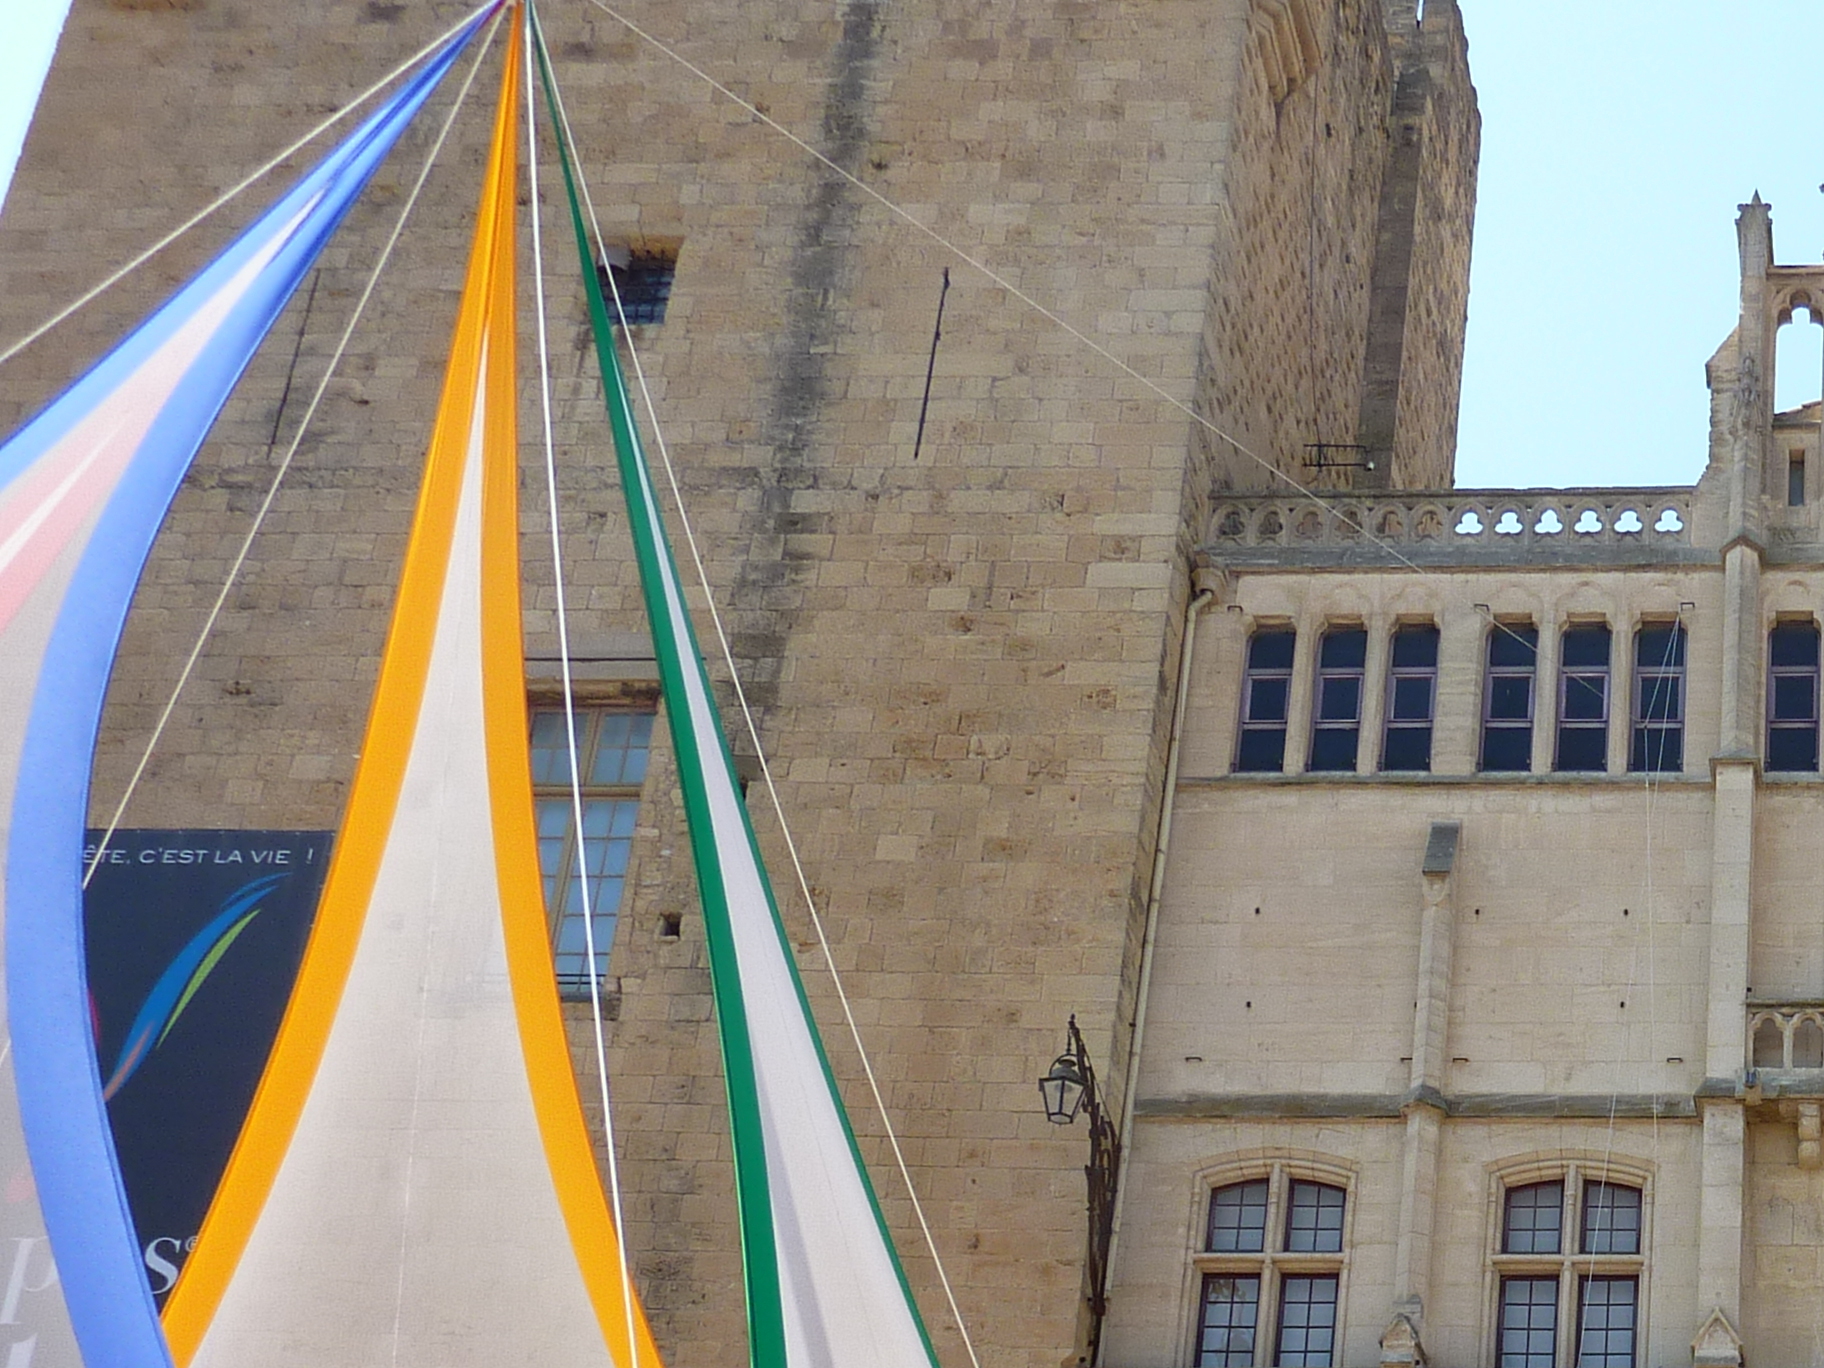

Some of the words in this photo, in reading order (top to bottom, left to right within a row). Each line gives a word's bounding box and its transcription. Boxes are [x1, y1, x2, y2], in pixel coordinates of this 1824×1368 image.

[138, 848, 208, 865] C'EST
[213, 849, 243, 865] LA
[250, 849, 291, 865] VIE
